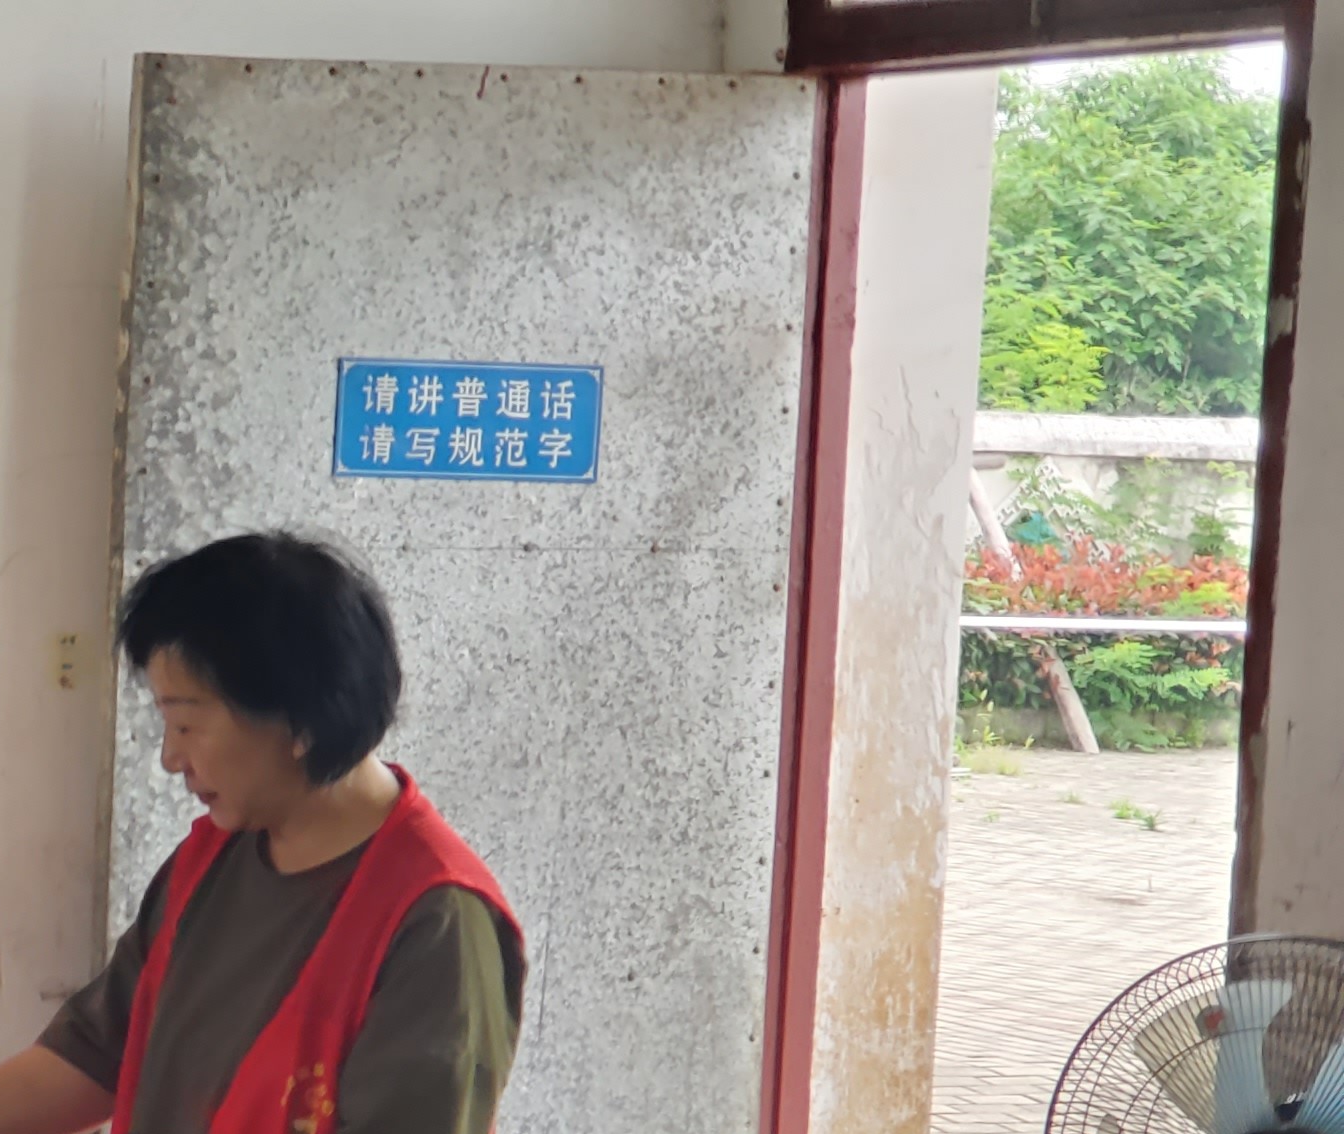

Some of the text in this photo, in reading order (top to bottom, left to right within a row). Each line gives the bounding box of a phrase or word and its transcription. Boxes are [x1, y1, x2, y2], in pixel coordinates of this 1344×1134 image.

[362, 372, 577, 421] 请讲普通话
[358, 421, 573, 469] 请写规范字
